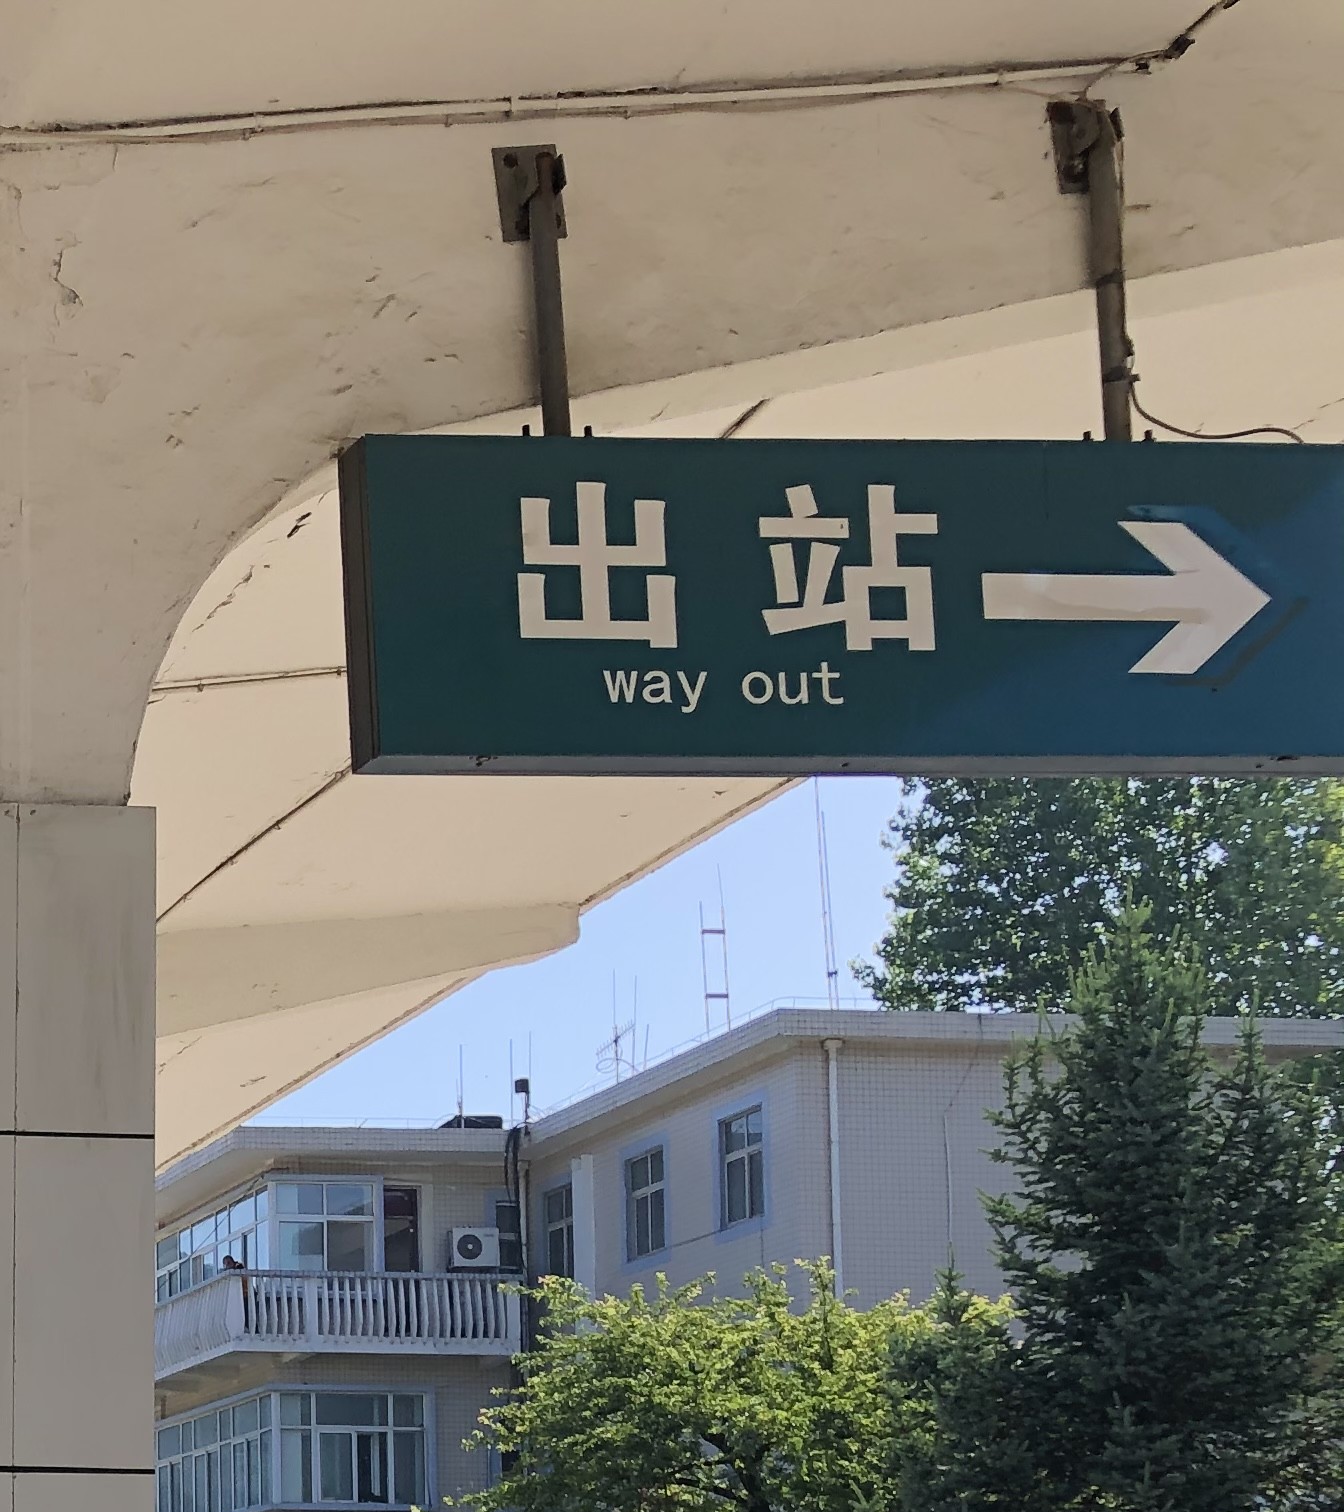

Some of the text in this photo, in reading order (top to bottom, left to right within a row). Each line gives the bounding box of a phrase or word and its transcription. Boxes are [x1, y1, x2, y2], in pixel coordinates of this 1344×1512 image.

[518, 482, 938, 650] 出站
[603, 661, 844, 714] way out
